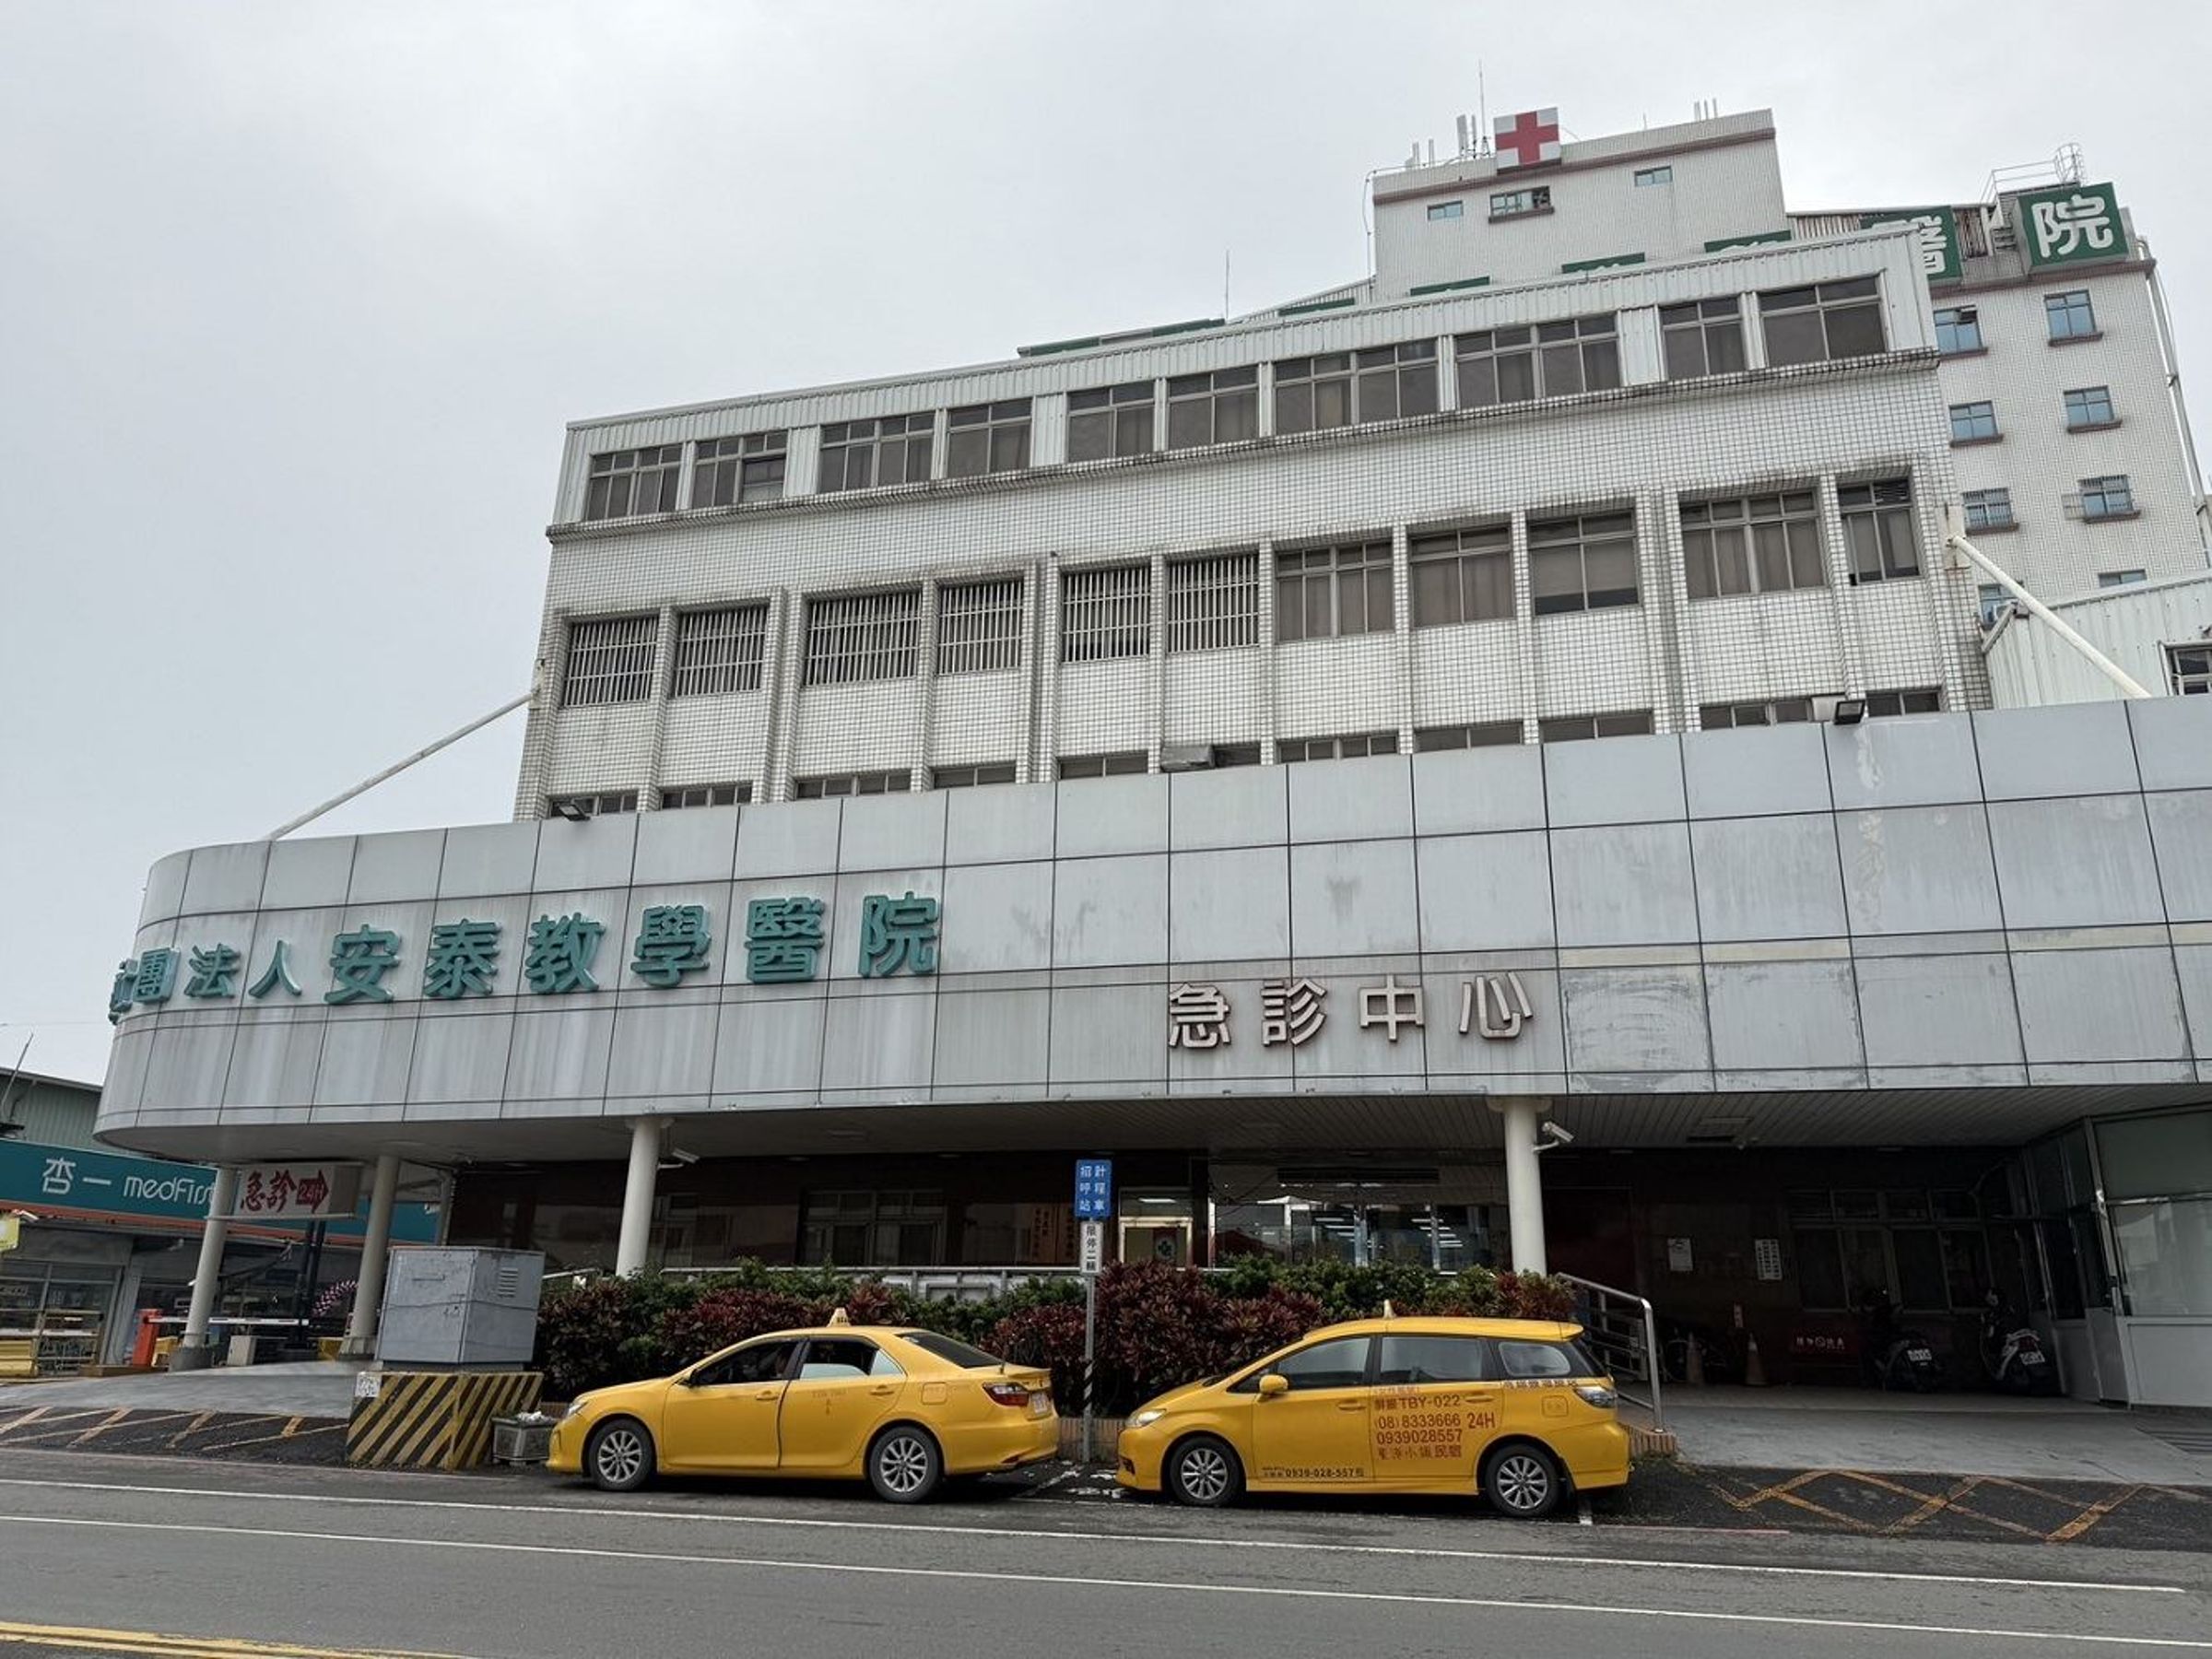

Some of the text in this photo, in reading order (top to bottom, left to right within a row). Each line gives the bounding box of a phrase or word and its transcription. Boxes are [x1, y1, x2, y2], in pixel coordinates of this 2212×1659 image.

[2030, 193, 2114, 259] 院
[1169, 971, 1535, 1051] 急診中心
[42, 1158, 112, 1194] 杏一
[241, 1169, 297, 1213] 急診
[1376, 1428, 1463, 1445] 0939028557
[1466, 1412, 1497, 1430] 24H
